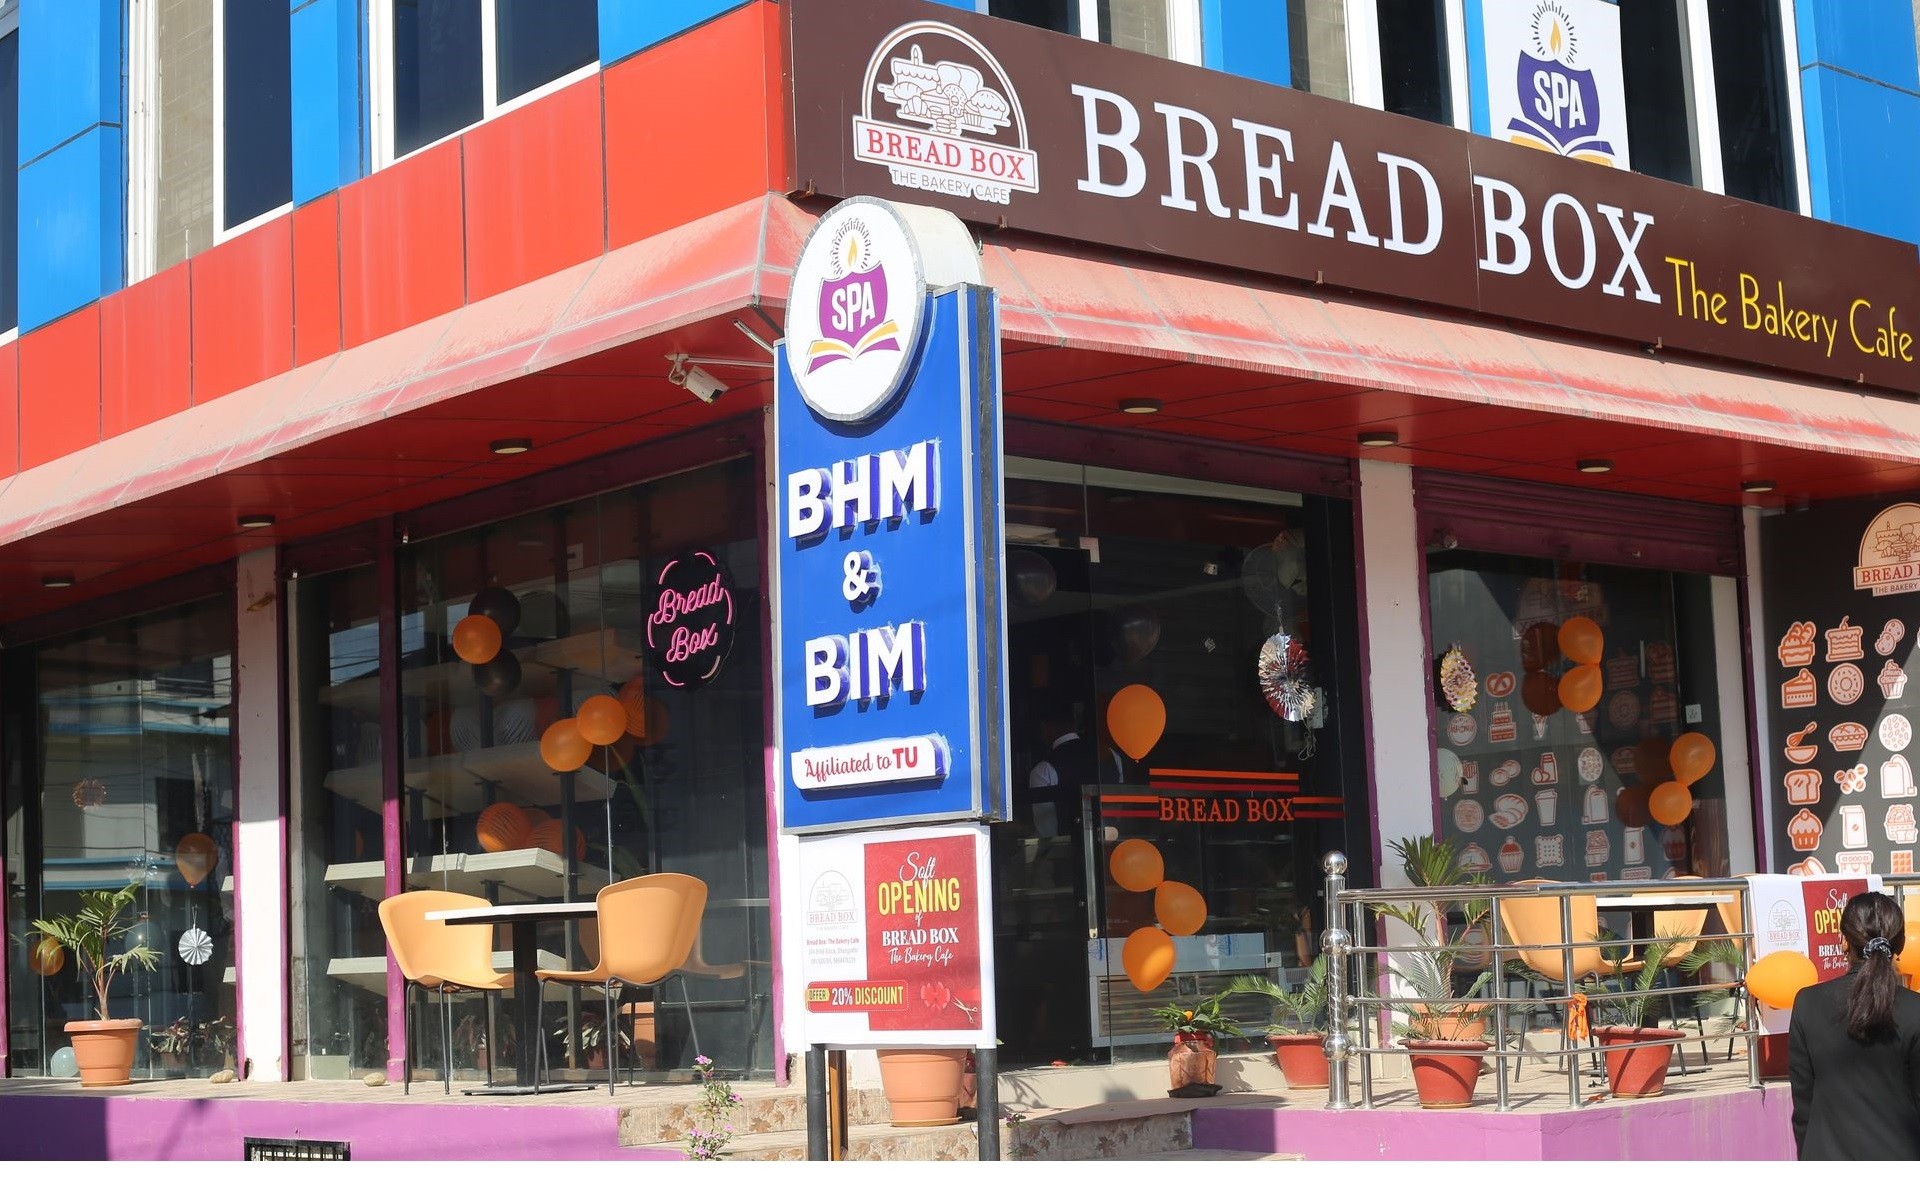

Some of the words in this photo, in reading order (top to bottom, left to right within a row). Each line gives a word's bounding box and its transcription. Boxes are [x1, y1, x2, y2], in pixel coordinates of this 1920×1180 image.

[1533, 70, 1587, 129] SPA
[866, 129, 962, 168] BREAD
[969, 148, 1026, 181] BOX
[891, 168, 917, 185] THE
[921, 174, 971, 194] BAKERY
[975, 184, 1008, 201] CAFE
[1071, 83, 1444, 256] BREAD
[1473, 174, 1662, 304] BOX
[831, 285, 875, 334] SPA
[1665, 256, 1728, 325] The
[1739, 273, 1838, 358] Bakery
[1849, 299, 1913, 363] Cafe
[788, 440, 932, 538] BHM
[842, 551, 874, 602] &
[1861, 565, 1913, 584] BREAD
[1874, 586, 1889, 595] THE
[1890, 582, 1918, 592] BAKERY
[653, 573, 725, 625] Bread
[666, 622, 719, 663] Box
[805, 622, 918, 707] BIM
[804, 752, 874, 782] Affiliated
[877, 752, 892, 770] to
[892, 746, 918, 769] TU
[1159, 798, 1241, 822] BREAD
[1246, 798, 1295, 822] BOX
[900, 851, 936, 889] Soft
[878, 877, 961, 916] OPENING
[809, 912, 836, 924] BREAD
[838, 910, 855, 922] BOX
[1814, 908, 1844, 935] OPEN
[882, 928, 927, 947] BREAD
[929, 927, 960, 945] BOX
[889, 947, 902, 965] The
[904, 946, 933, 968] Bakery
[934, 945, 954, 967] Cafe
[809, 989, 827, 1001] OFFER
[831, 987, 853, 1006] 20%
[854, 985, 904, 1006] DISCOUNT
